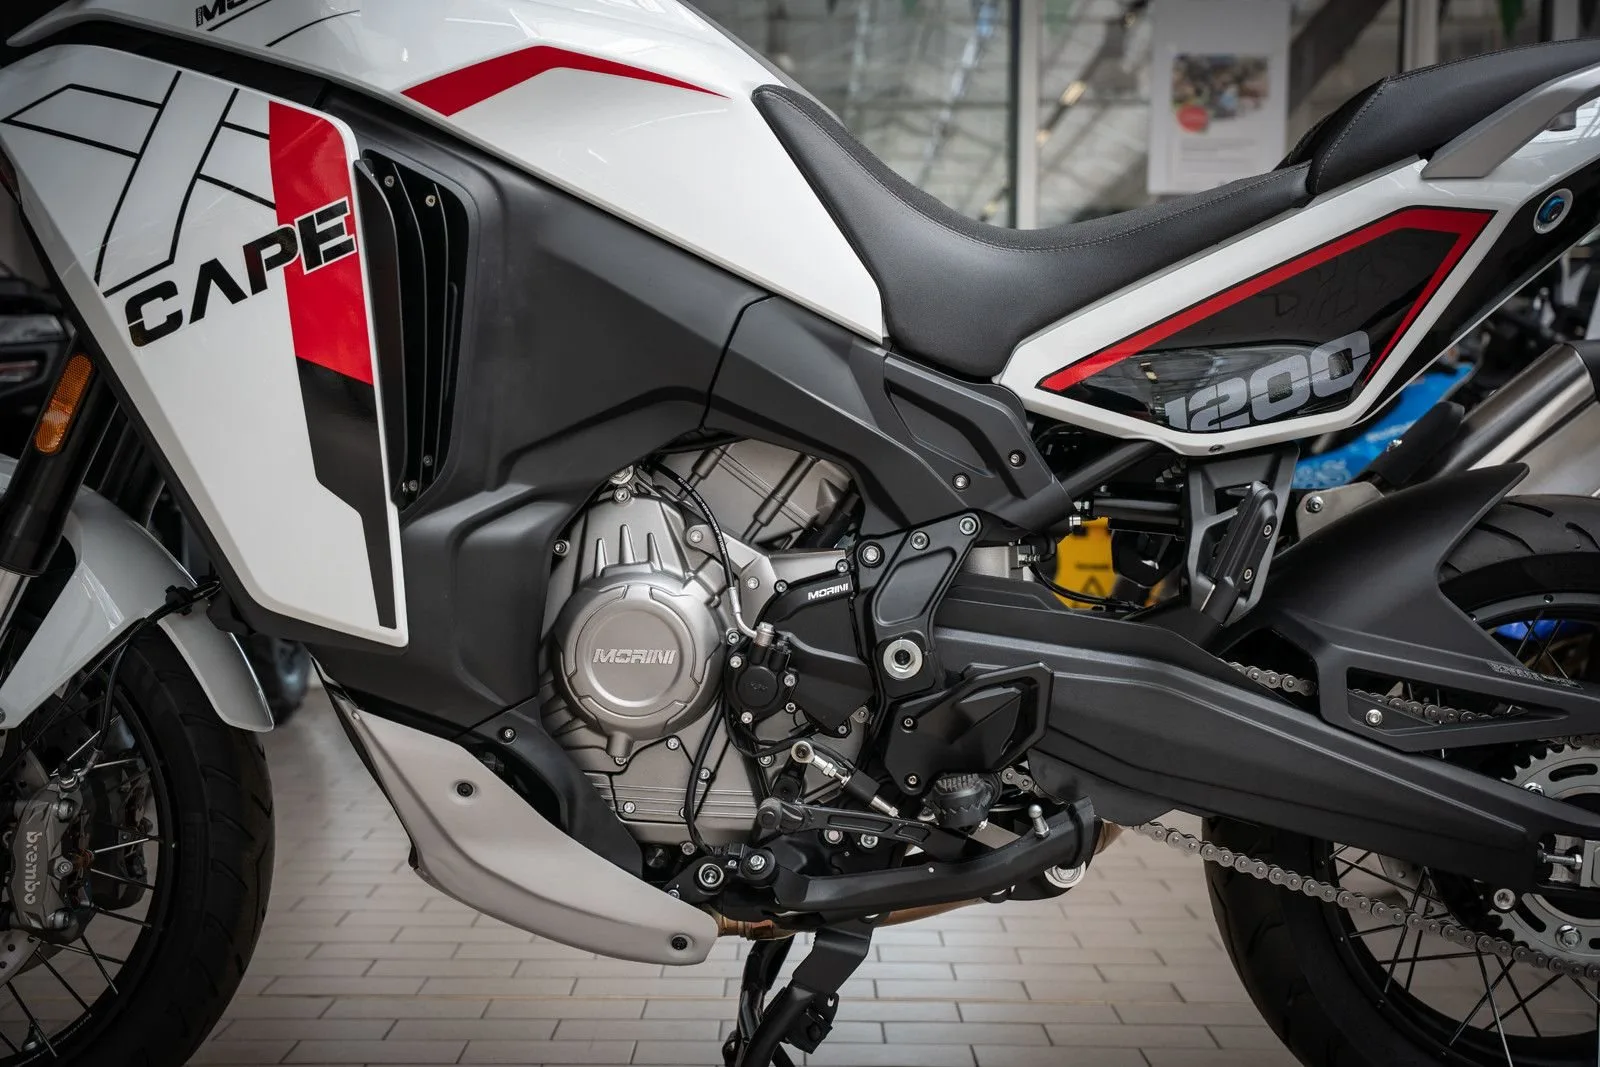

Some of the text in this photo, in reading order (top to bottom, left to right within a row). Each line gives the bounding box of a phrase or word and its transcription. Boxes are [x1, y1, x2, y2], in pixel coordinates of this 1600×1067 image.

[124, 196, 357, 348] CAPE
[1164, 330, 1371, 431] 1200
[807, 582, 849, 601] MORINI
[592, 648, 676, 665] MORINI
[24, 831, 43, 905] brembo
